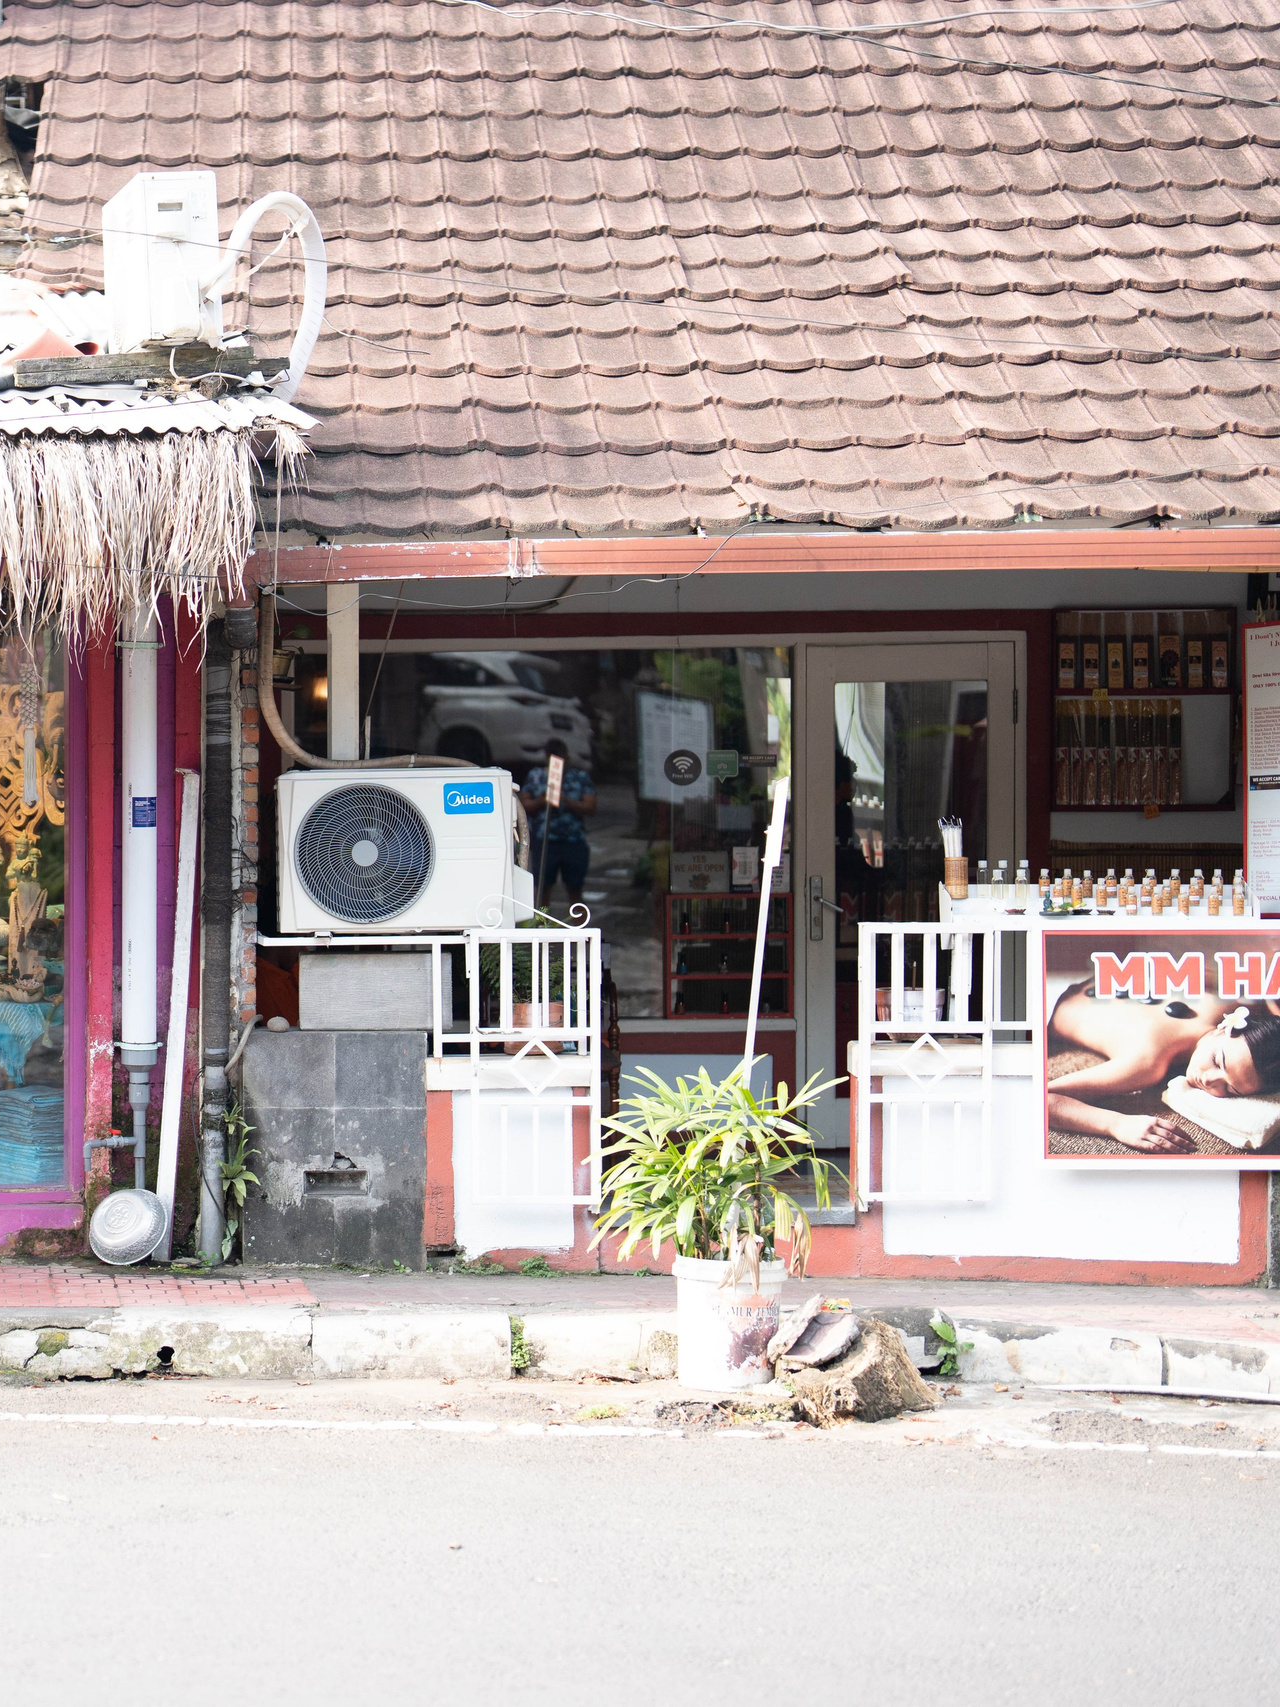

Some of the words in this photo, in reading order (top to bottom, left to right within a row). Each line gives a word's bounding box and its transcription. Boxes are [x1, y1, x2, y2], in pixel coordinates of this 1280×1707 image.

[447, 790, 491, 807] Midea
[692, 855, 706, 863] YES
[704, 864, 725, 872] OPEN
[1091, 952, 1205, 999] MM
